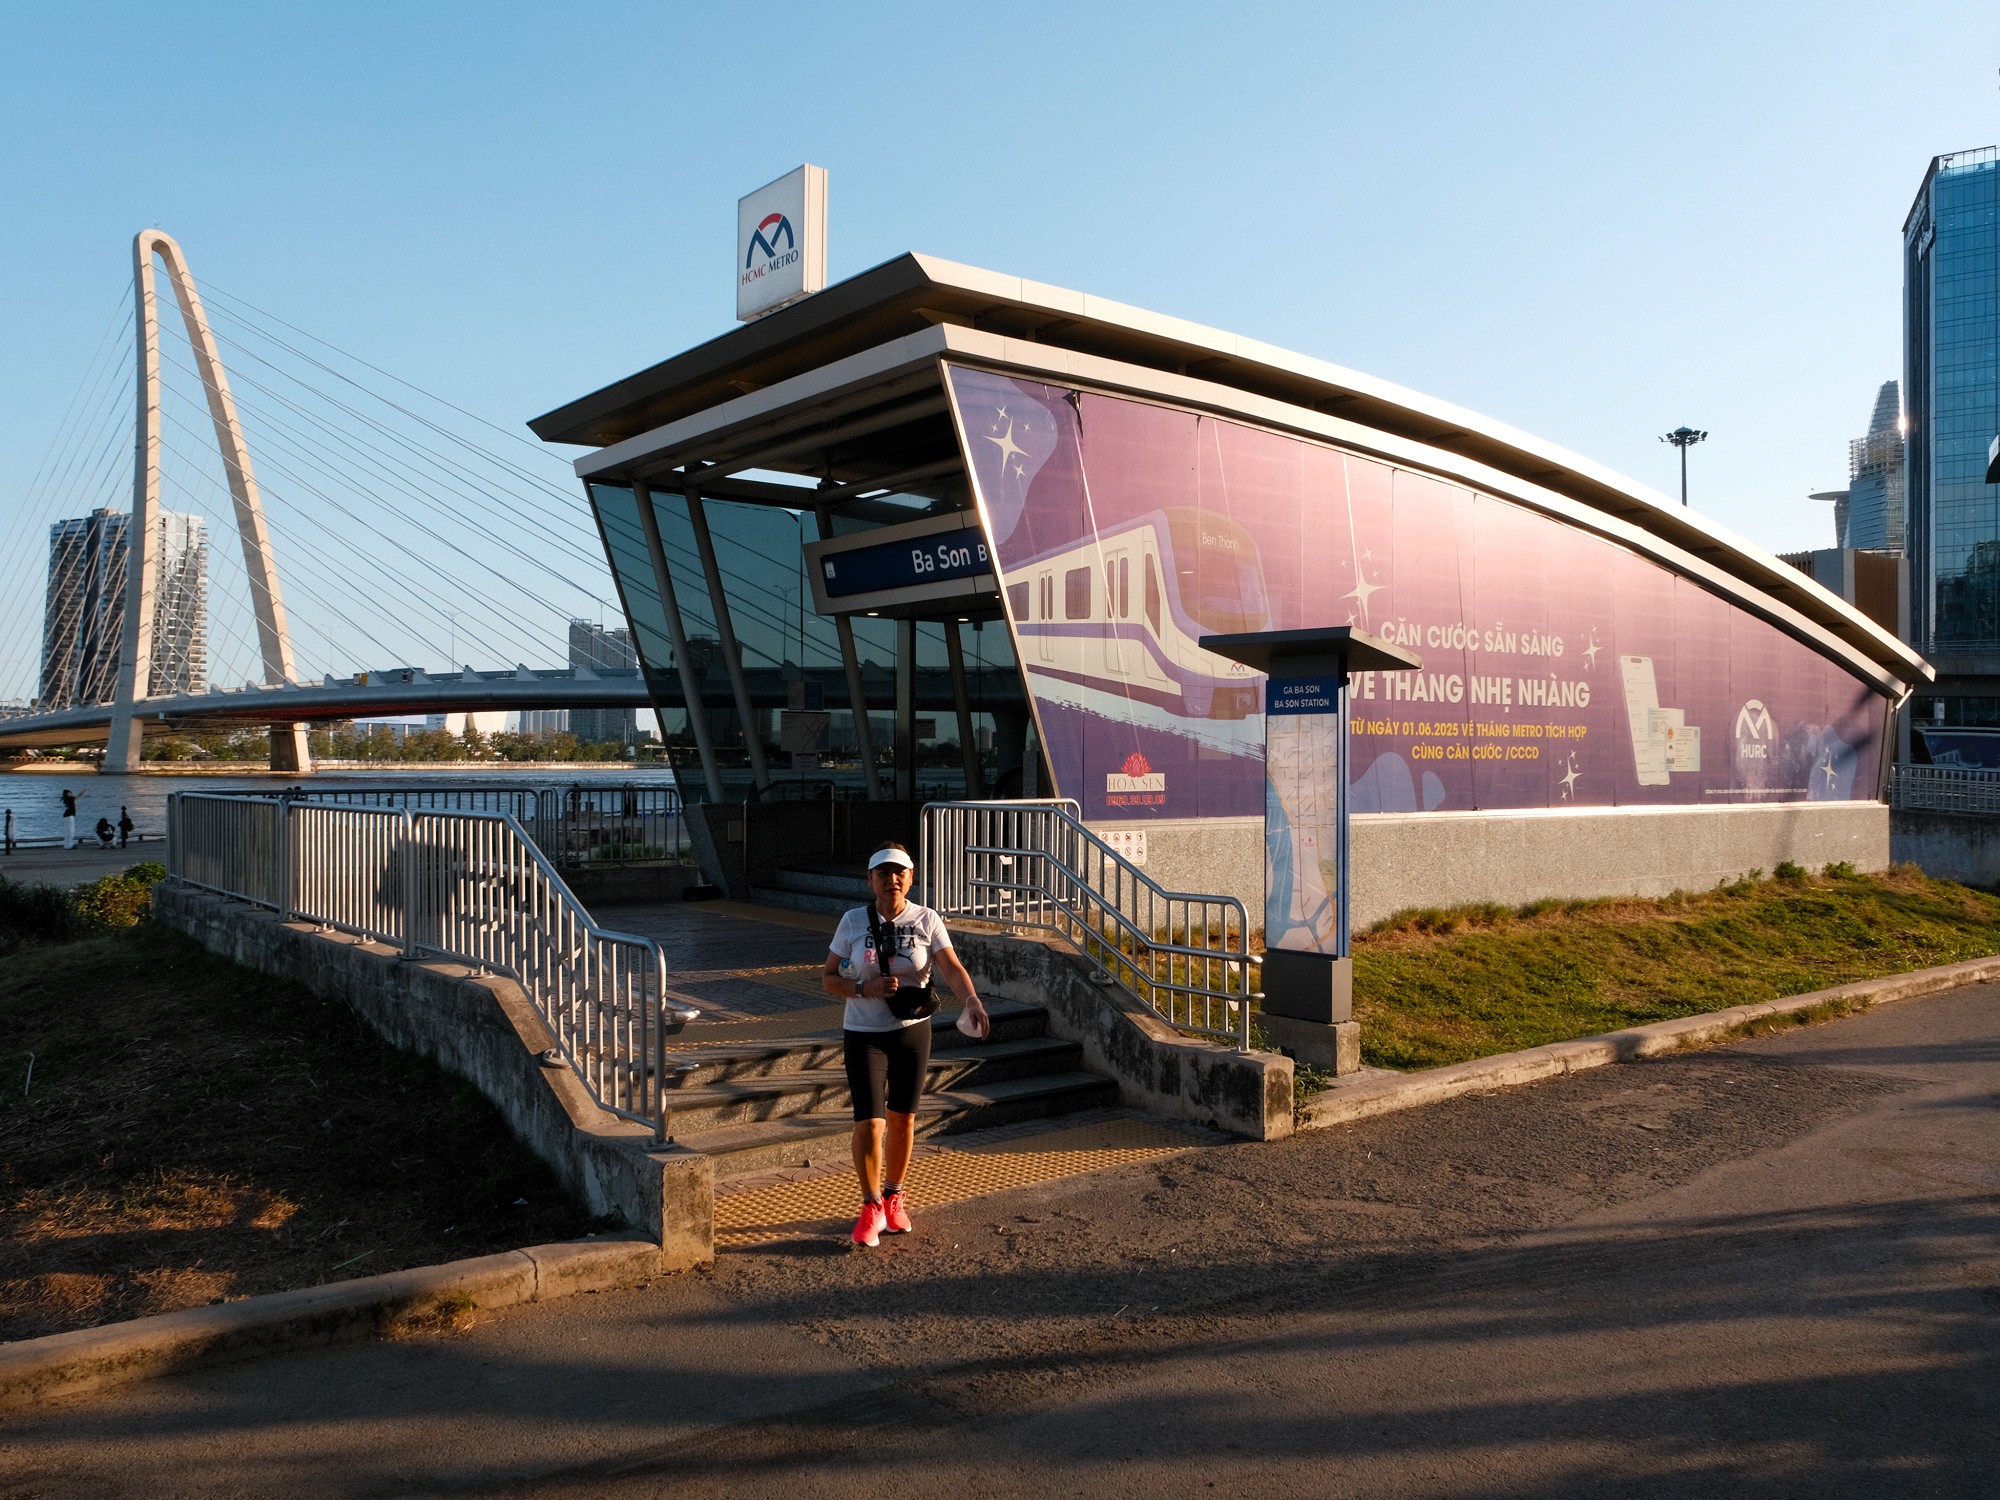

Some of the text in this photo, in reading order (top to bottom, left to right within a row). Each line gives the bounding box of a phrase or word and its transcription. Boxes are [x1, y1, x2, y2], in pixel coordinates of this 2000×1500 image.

[742, 249, 799, 286] HCMC METRO
[1202, 532, 1217, 546] Ben
[912, 549, 935, 574] Ba
[938, 545, 972, 568] Son
[1380, 617, 1564, 657] CĂN CƯỚC SẴN SÀNG
[1283, 685, 1320, 694] GA BA SON
[1471, 676, 1512, 713] NHẸ
[1518, 672, 1591, 708] NHÀNG
[1274, 698, 1330, 708] BA SON STATION
[1350, 716, 1588, 741] TỪ NGÀY 01.06.2025 VÉ THÁNG METRO TÍCH HỢP
[1411, 742, 1444, 760] CÙNG
[1446, 742, 1470, 760] CĂN
[1472, 743, 1503, 760] CƯỚC
[1741, 744, 1768, 758] HURC
[1108, 778, 1137, 790] HOA
[864, 935, 916, 949] GTA
